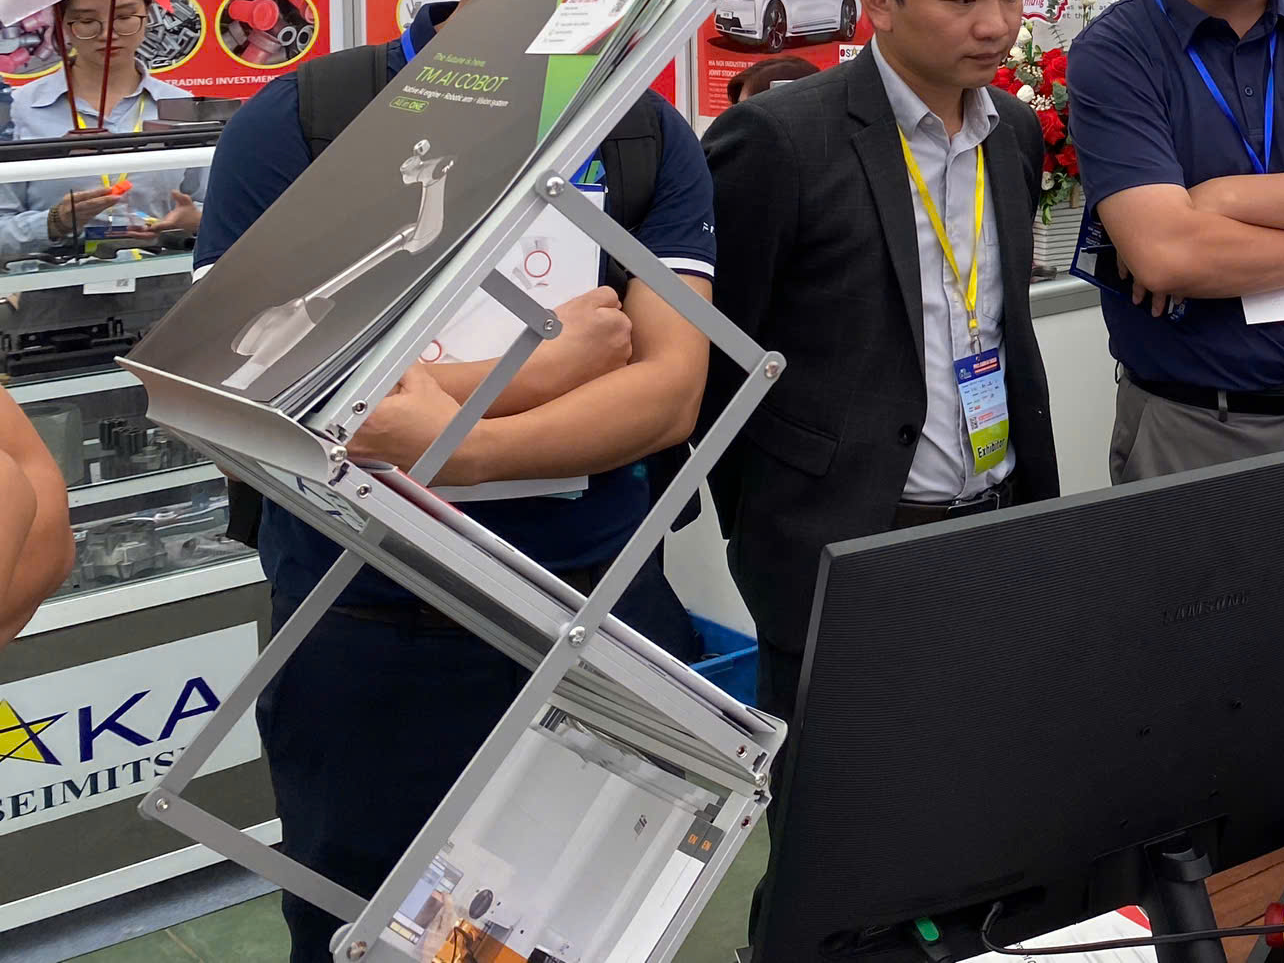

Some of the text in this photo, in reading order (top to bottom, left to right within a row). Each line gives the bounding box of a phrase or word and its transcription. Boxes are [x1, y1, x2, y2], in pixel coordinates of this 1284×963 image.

[165, 77, 213, 87] TRADING
[415, 66, 509, 92] TM AI COBOT
[0, 676, 221, 766] AKA
[0, 746, 187, 823] EIMITS
